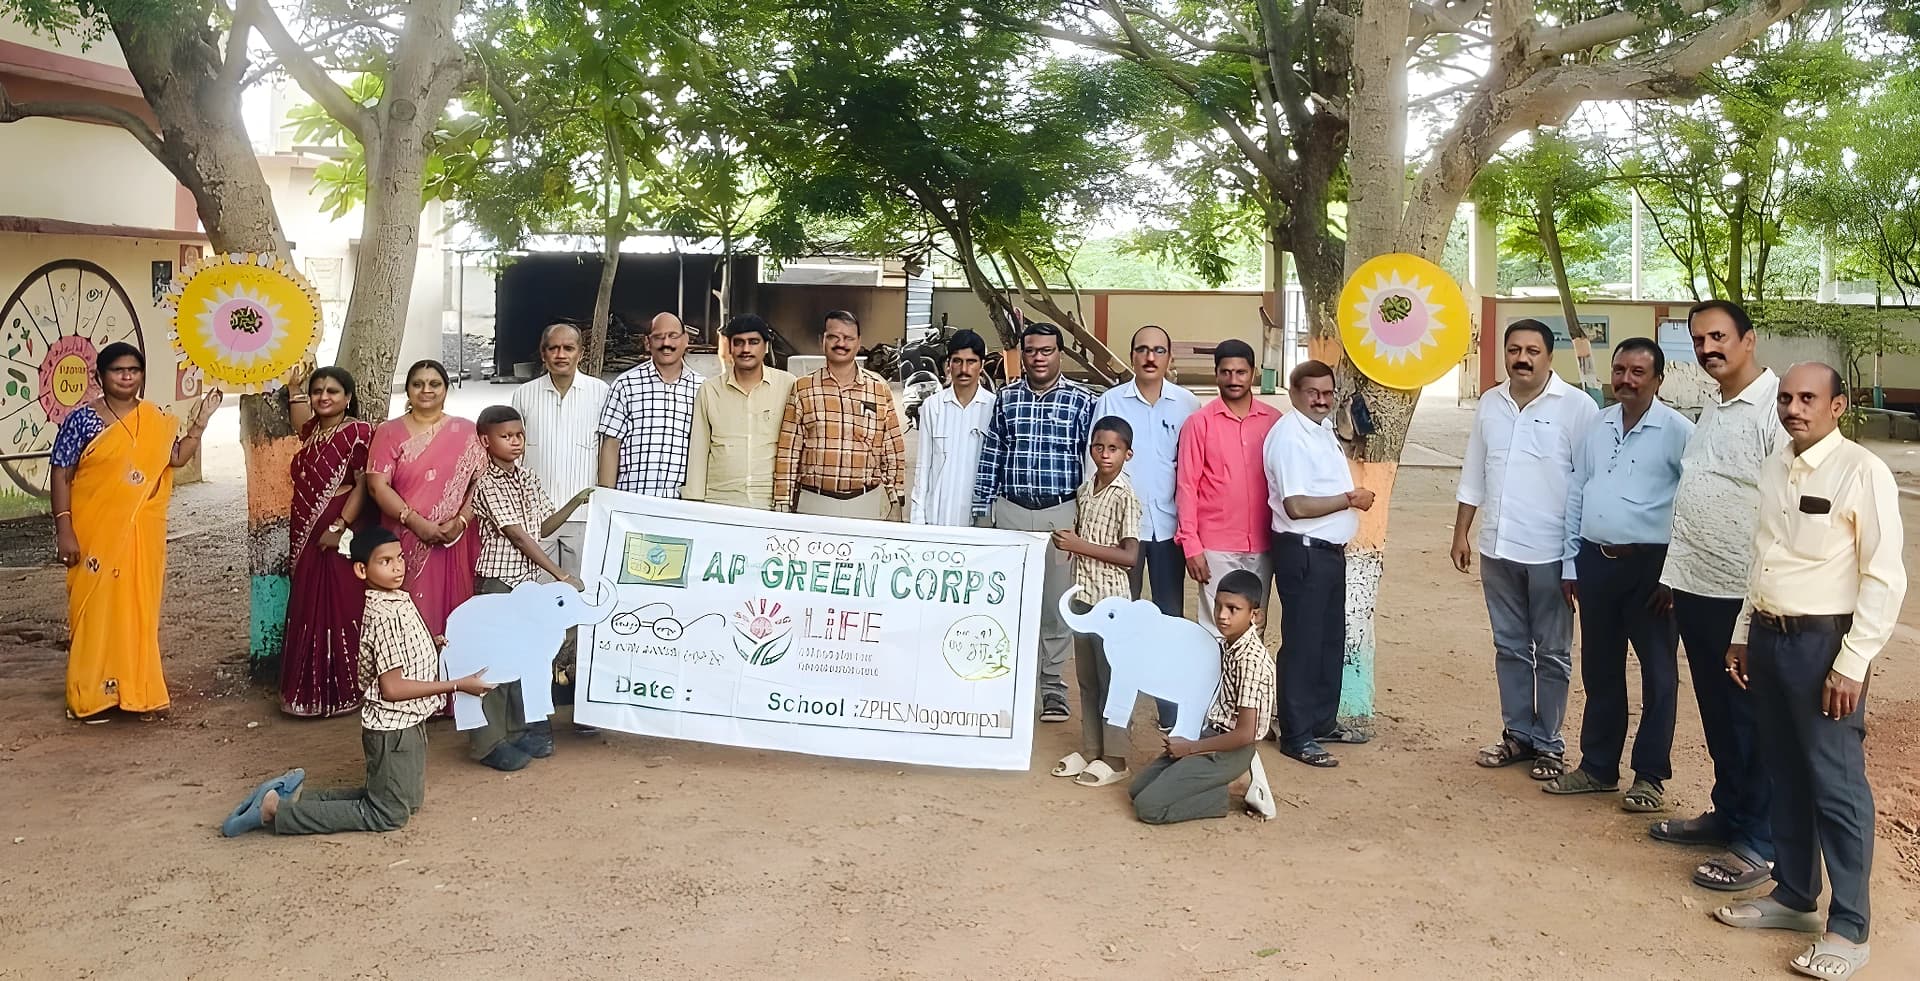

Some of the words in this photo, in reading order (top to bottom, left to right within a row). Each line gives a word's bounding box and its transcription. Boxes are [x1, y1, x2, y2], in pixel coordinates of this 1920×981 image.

[702, 551, 746, 584] AP
[761, 556, 878, 597] GREEN
[890, 566, 1006, 605] CORPS
[616, 675, 675, 699] Date
[767, 692, 845, 717] School
